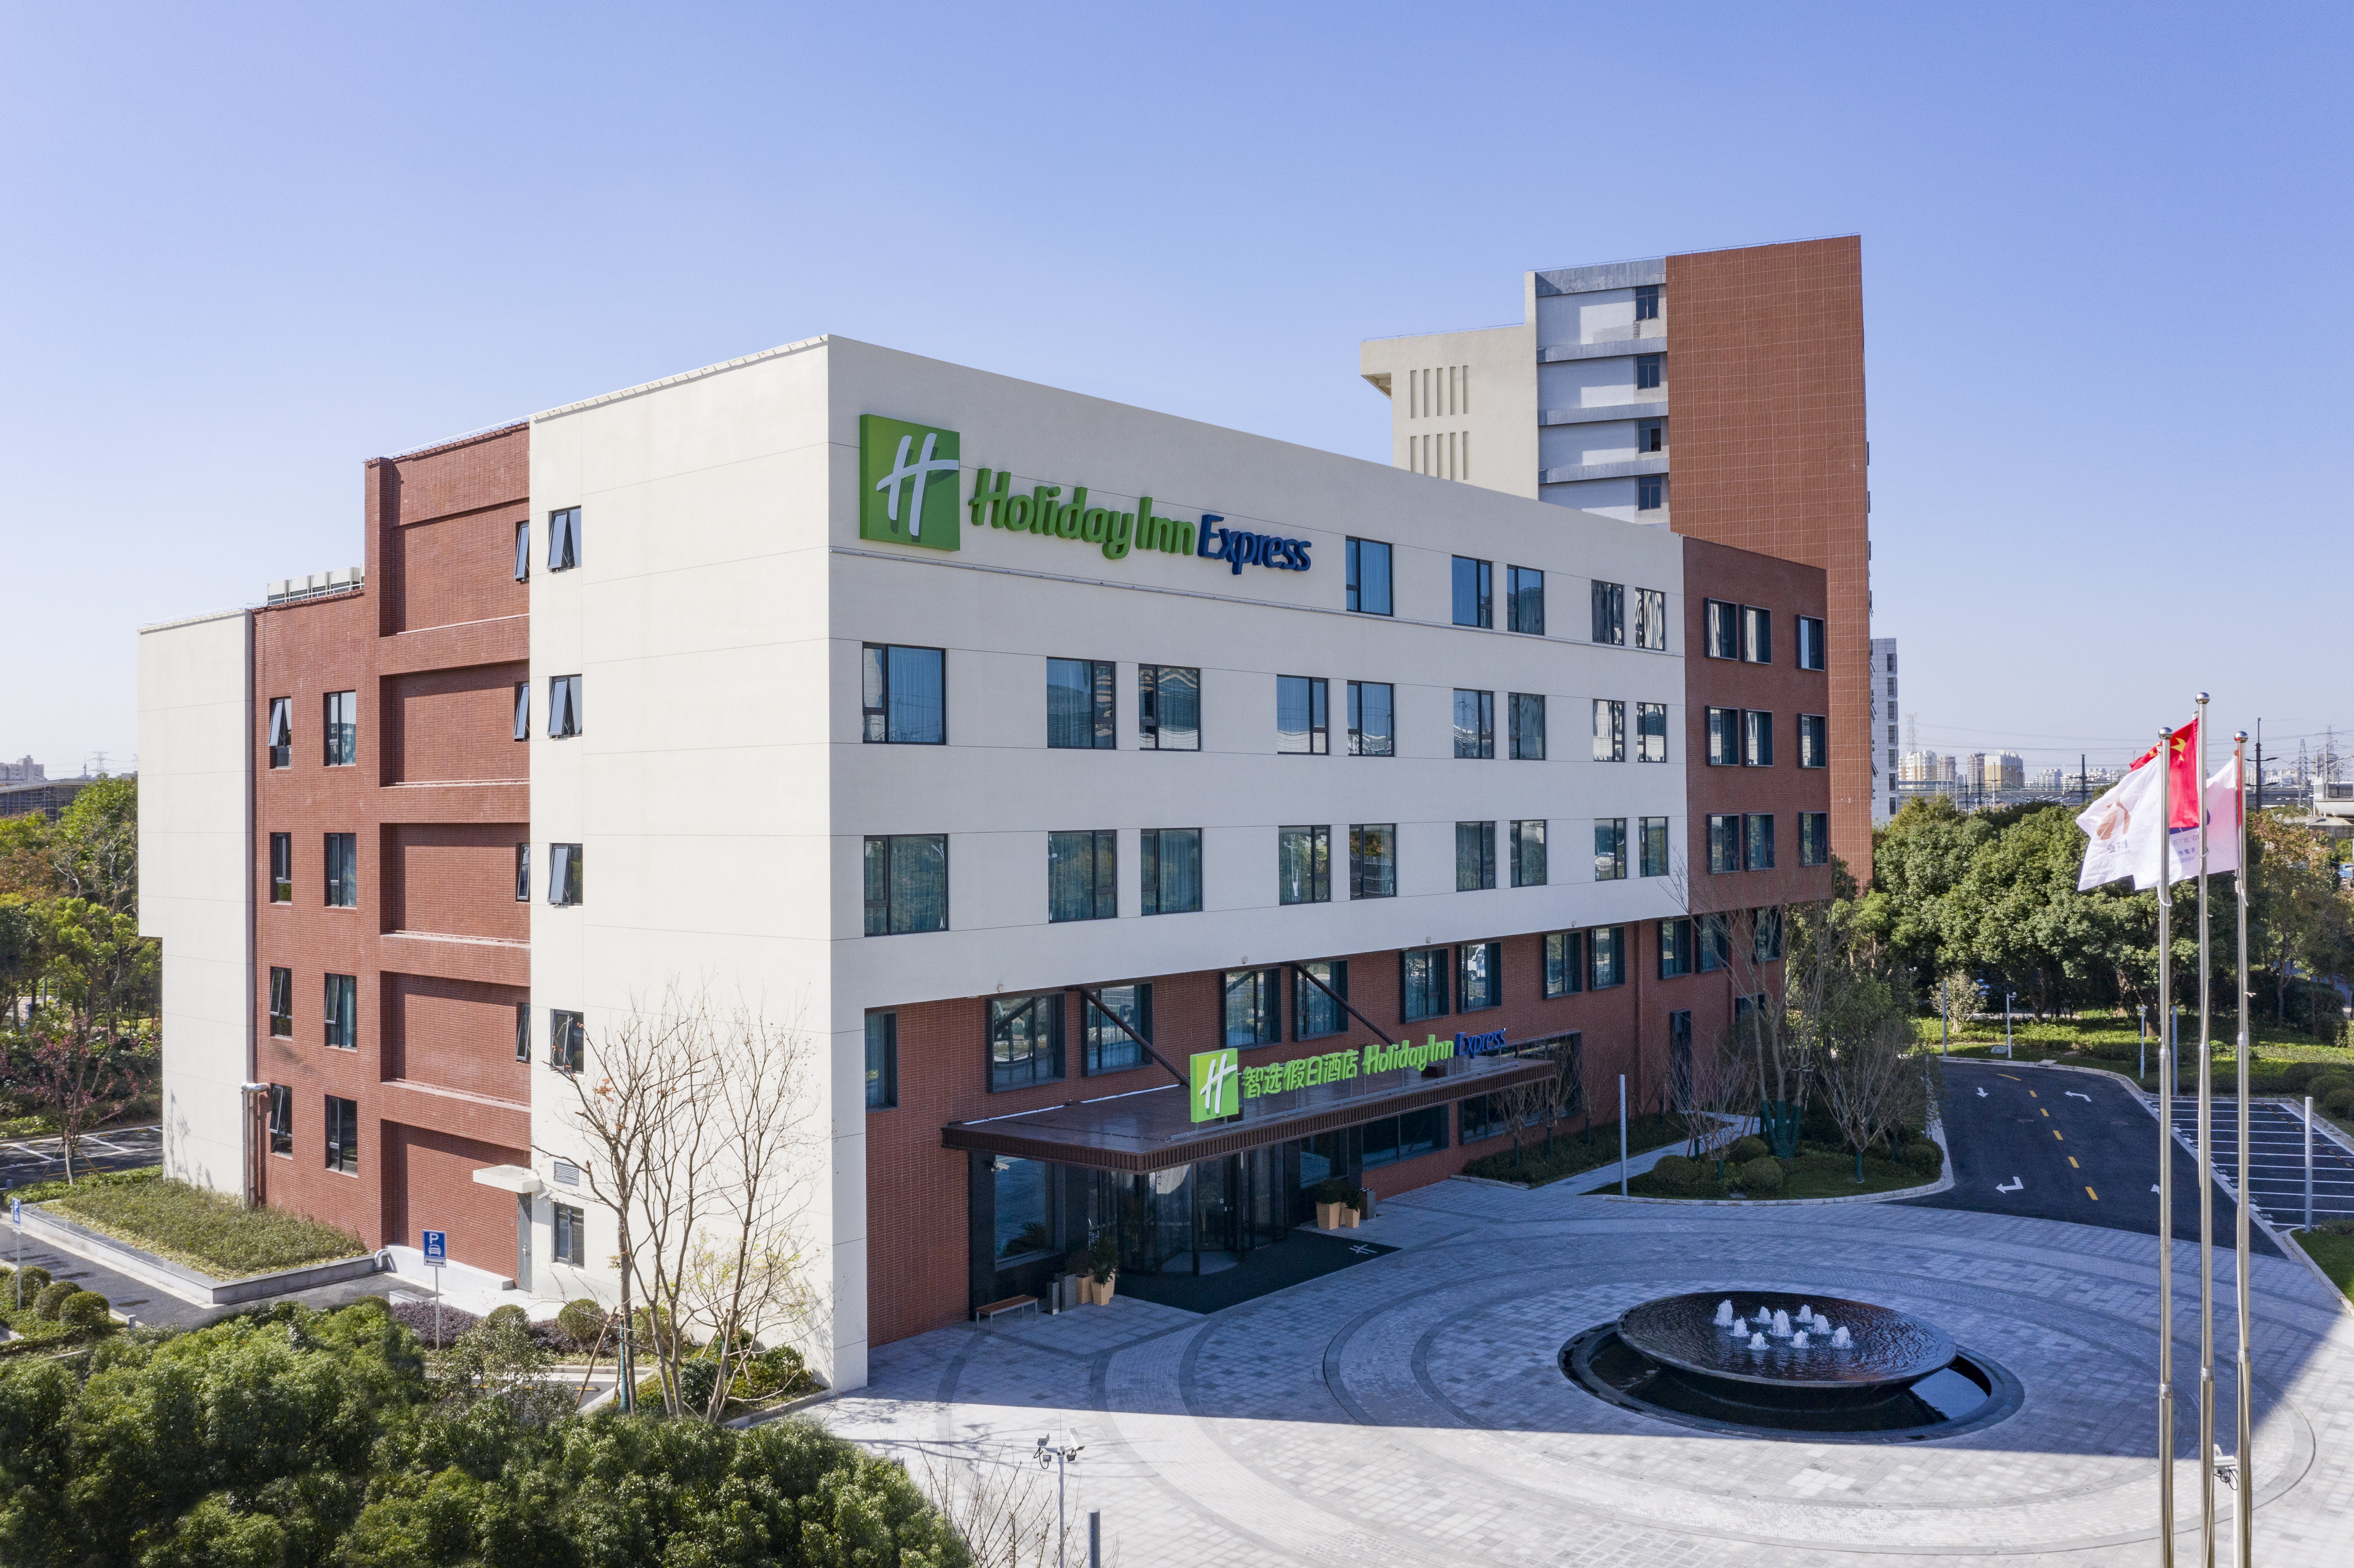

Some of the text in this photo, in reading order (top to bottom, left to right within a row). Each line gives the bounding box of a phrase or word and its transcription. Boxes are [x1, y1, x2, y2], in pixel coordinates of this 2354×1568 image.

[1197, 514, 1312, 576] Express
[1241, 1049, 1359, 1098] 智选假日酒店
[1455, 1030, 1507, 1059] Express
[14, 1201, 19, 1211] P
[429, 1232, 439, 1244] P
